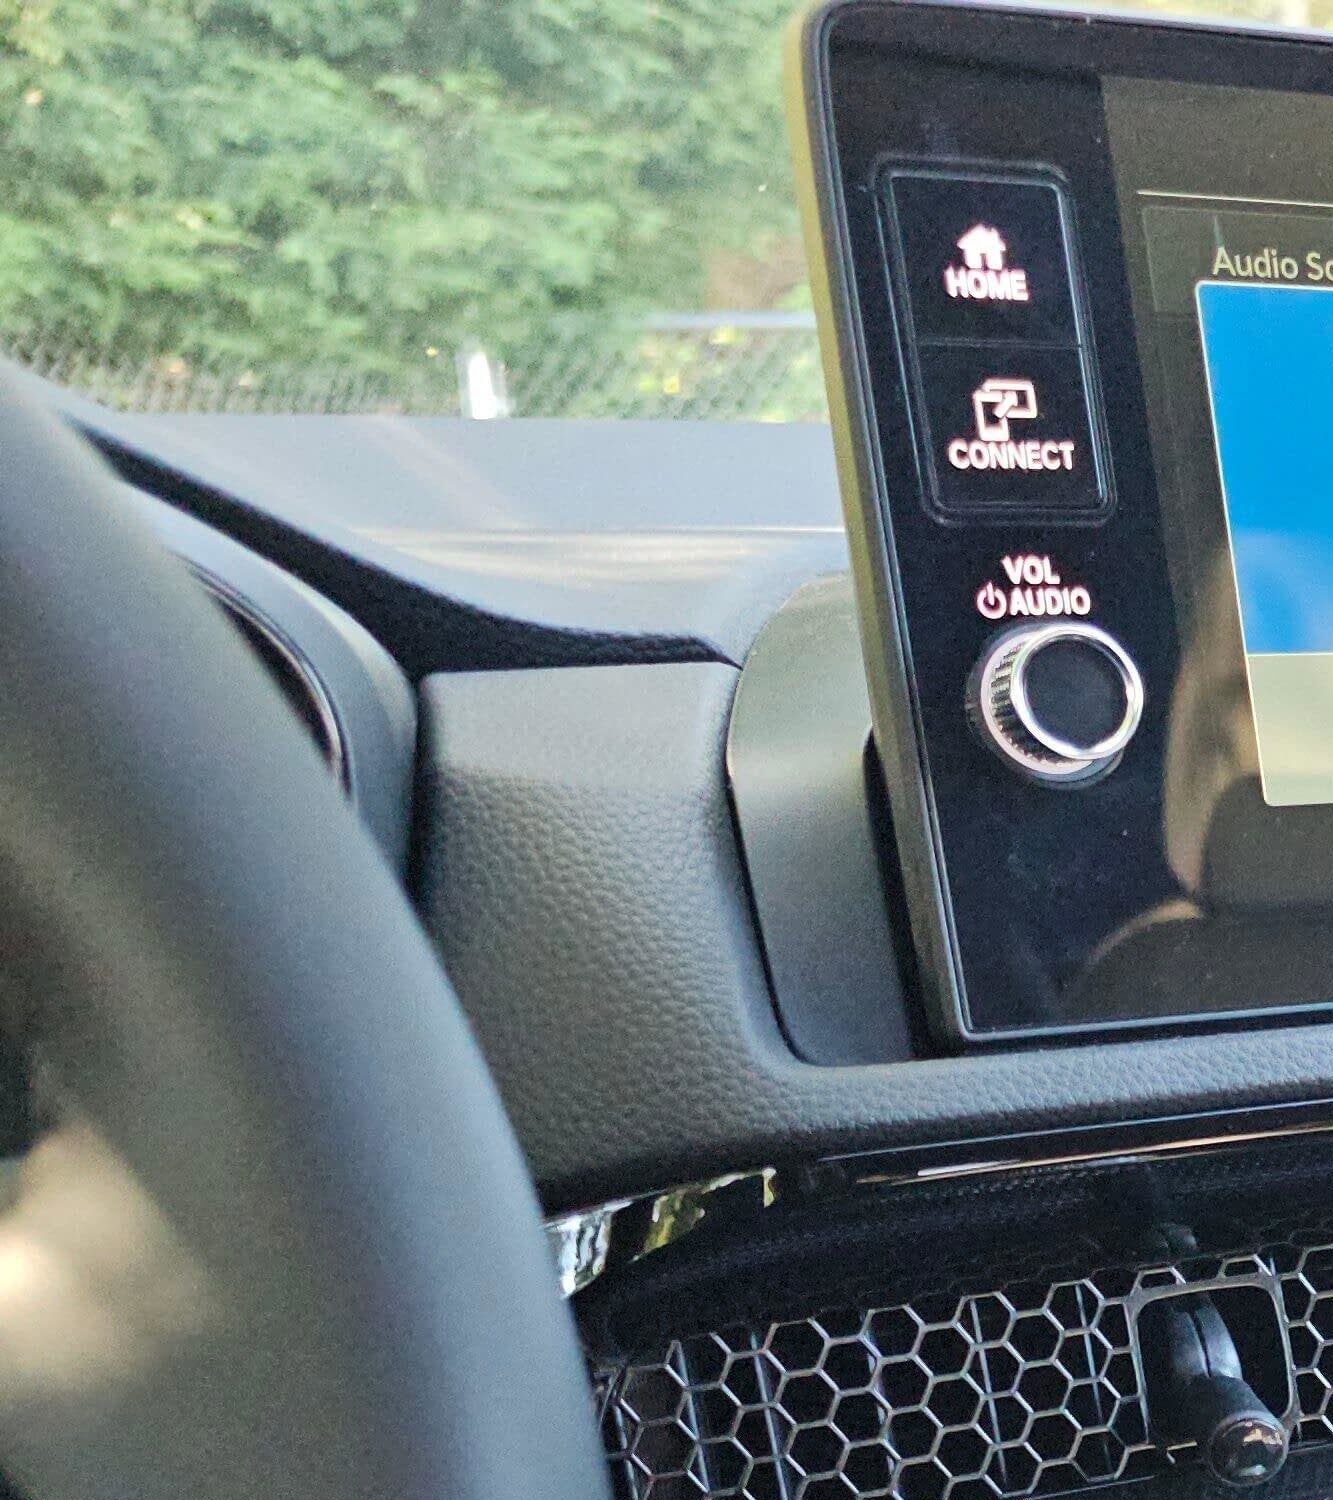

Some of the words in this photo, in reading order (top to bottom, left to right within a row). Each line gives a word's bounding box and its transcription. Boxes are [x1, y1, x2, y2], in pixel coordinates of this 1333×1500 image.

[1212, 246, 1299, 281] Audio
[942, 268, 1029, 301] HOME
[948, 440, 1075, 471] CONNECT
[1002, 554, 1060, 585] VOL
[1008, 586, 1091, 616] AUDIO
